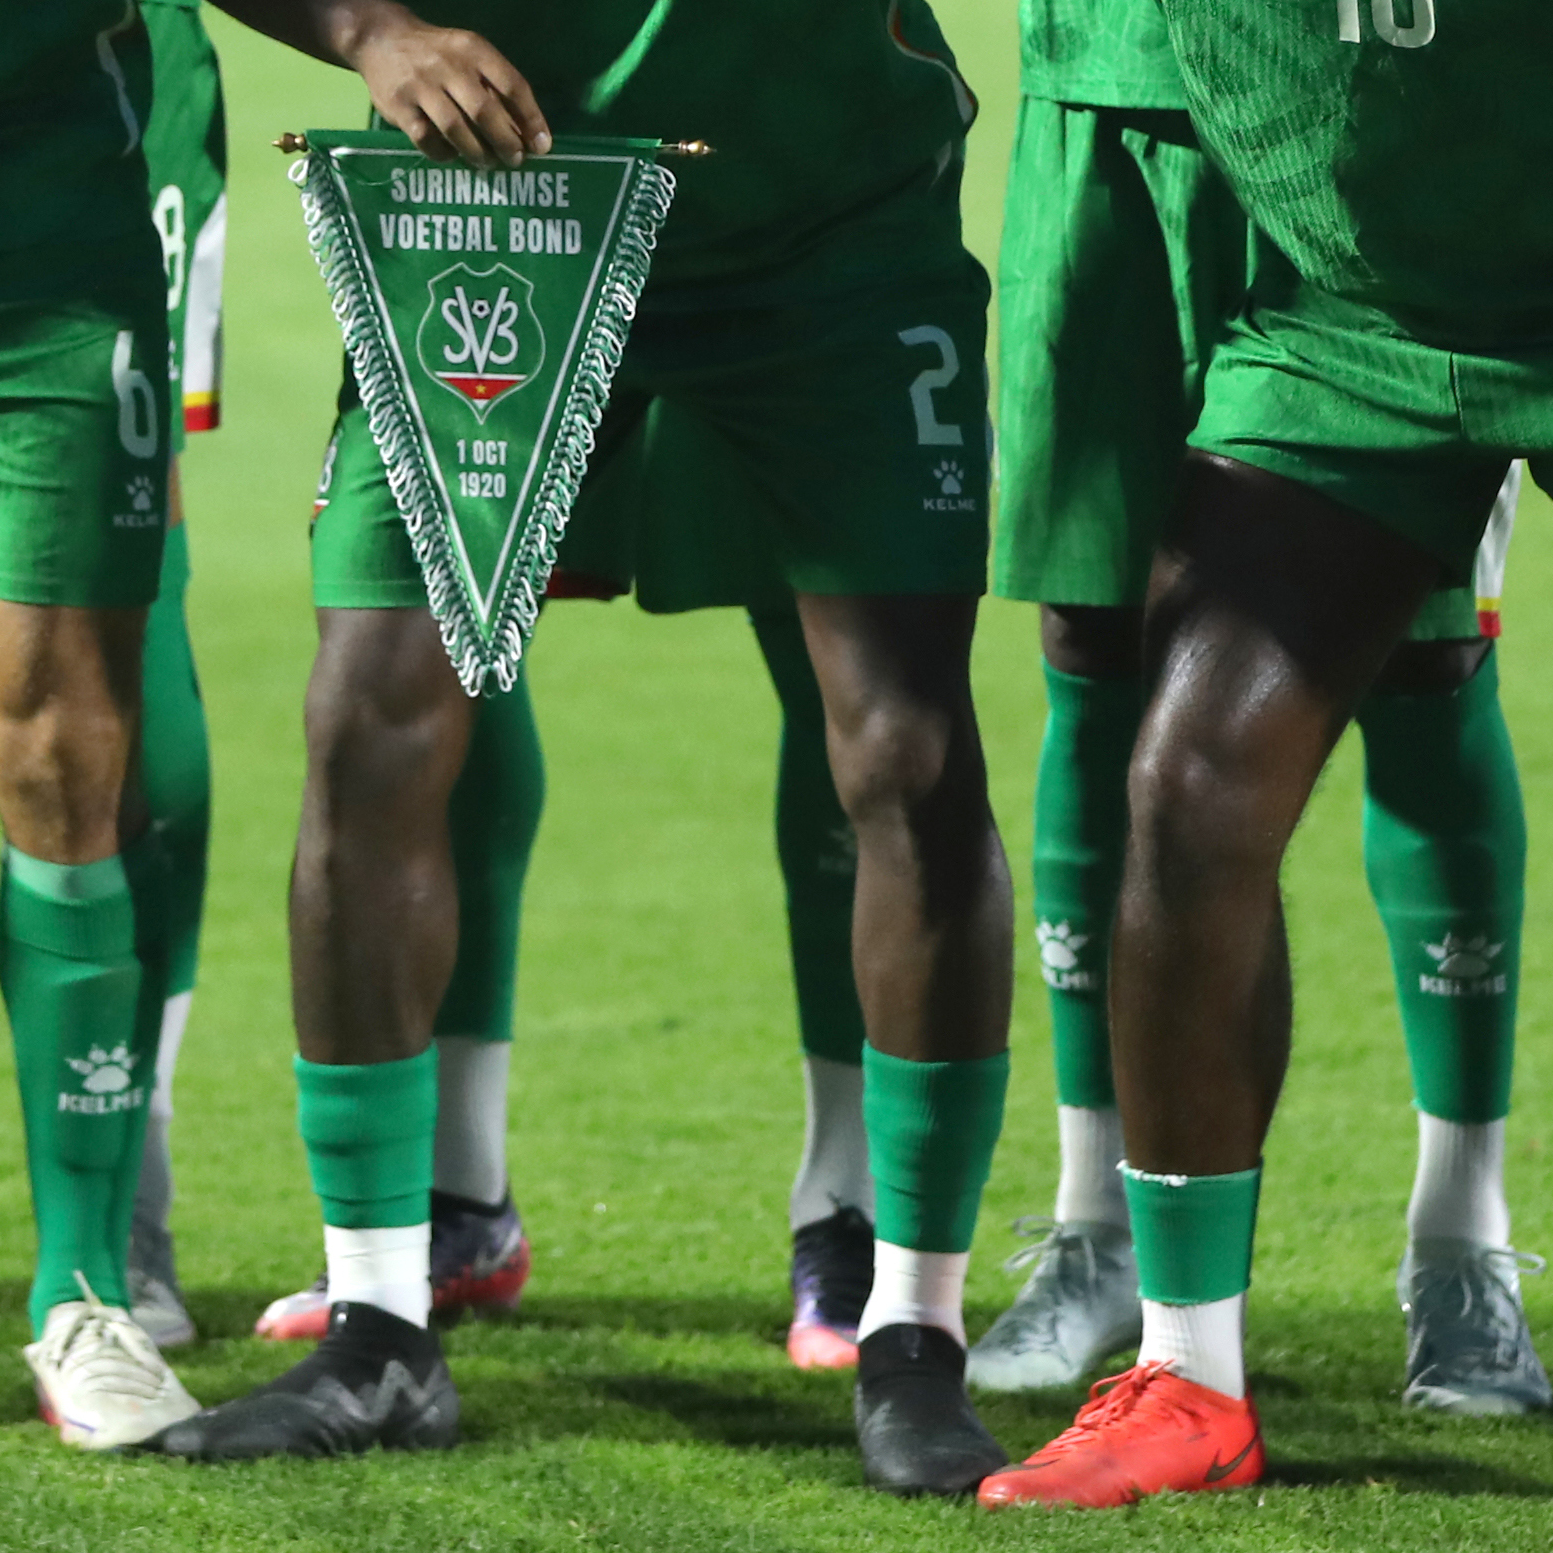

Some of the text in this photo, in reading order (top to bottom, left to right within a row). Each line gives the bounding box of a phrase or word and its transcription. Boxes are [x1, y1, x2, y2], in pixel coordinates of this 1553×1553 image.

[391, 167, 570, 207] SURINAAMSE
[379, 213, 582, 255] VOETBAL BOND
[111, 330, 158, 459] 6
[898, 324, 964, 445] 2
[456, 439, 508, 466] 1 OCT
[458, 471, 507, 499] 1920
[923, 498, 976, 512] KELME
[58, 1088, 144, 1115] KELME
